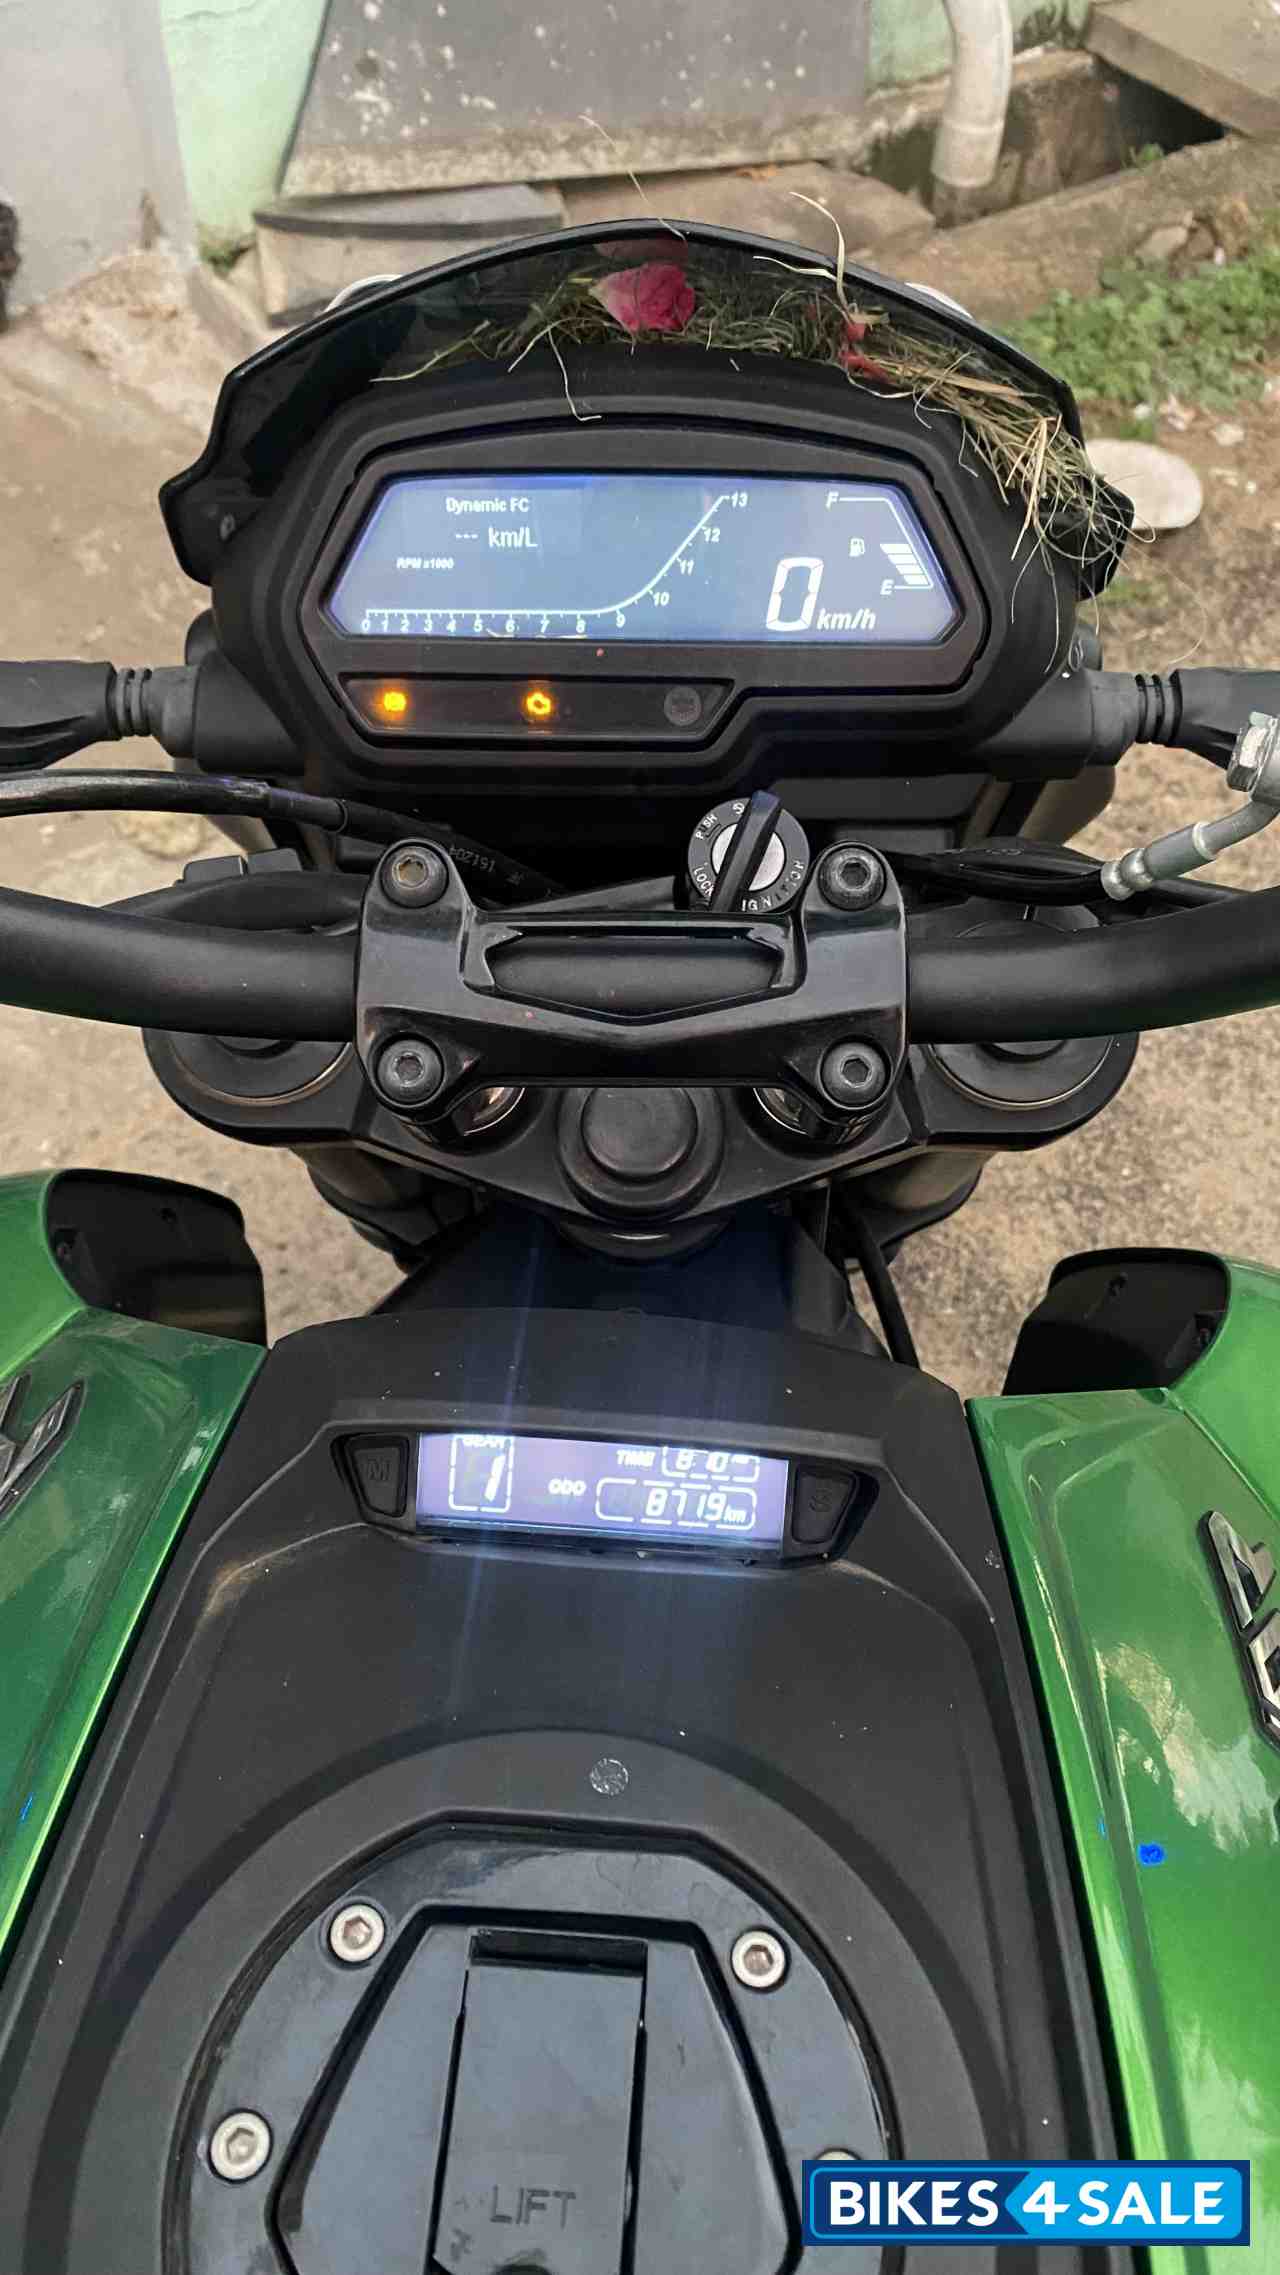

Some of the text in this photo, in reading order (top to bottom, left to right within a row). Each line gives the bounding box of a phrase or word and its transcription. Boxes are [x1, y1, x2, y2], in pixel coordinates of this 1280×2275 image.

[446, 497, 530, 514] Dynamic FC
[732, 492, 748, 507] 13
[826, 492, 839, 508] F
[488, 526, 538, 548] km/L
[704, 528, 720, 543] 12
[396, 557, 421, 569] RPM
[680, 560, 695, 576] 11
[766, 556, 877, 632] 0 km/h
[880, 579, 895, 596] E
[653, 592, 670, 606] 10
[361, 614, 626, 633] 0 1 2 3 4 5 6 7 8 9
[695, 813, 718, 840] PUSH
[693, 867, 715, 898] LOCK
[484, 1455, 506, 1502] 1
[548, 1479, 747, 1528] ODO 8719 km
[489, 2183, 577, 2230] LIFT
